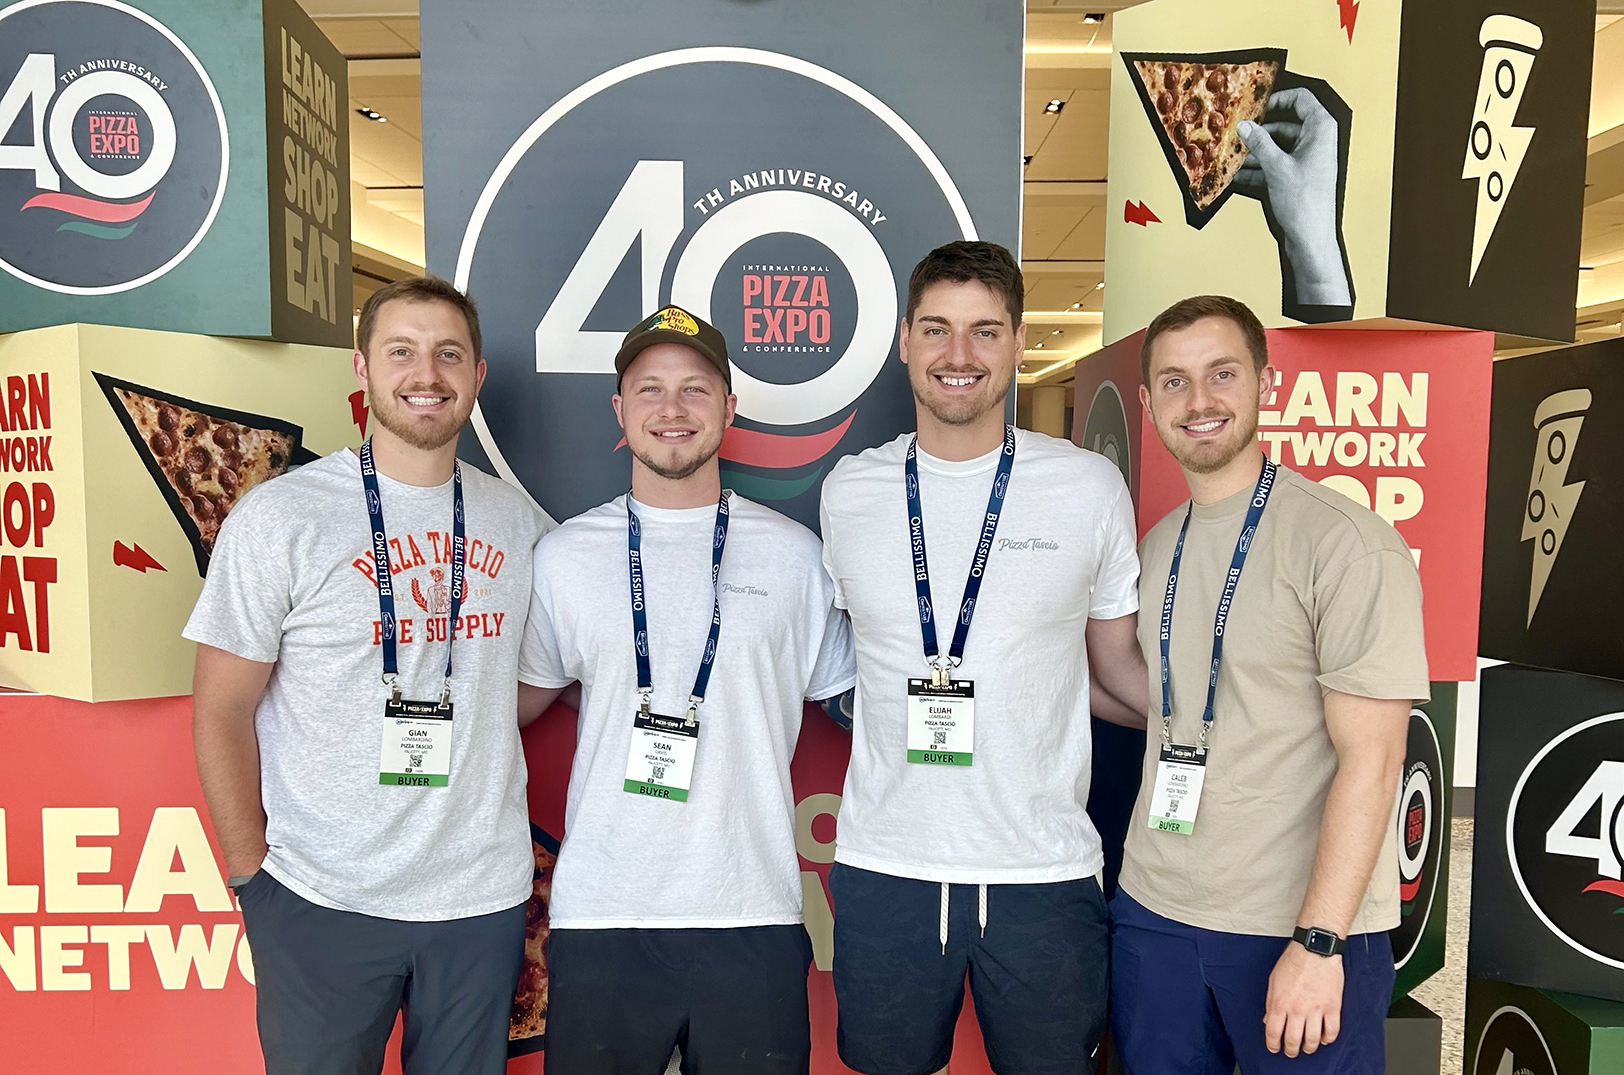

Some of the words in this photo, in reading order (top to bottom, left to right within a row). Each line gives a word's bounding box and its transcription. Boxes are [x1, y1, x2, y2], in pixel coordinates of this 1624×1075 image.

[60, 73, 76, 85] TH
[79, 59, 168, 91] ANNIVERSARY
[280, 26, 336, 131] LEARN
[88, 115, 139, 134] PIZZA
[282, 88, 338, 168] NETWORK
[90, 133, 140, 155] EXPO
[283, 136, 339, 230] SHOP
[693, 188, 725, 215] TH
[729, 169, 887, 226] ANNIVERSARY
[285, 206, 340, 325] EAT
[742, 264, 830, 272] INTERNATIONAL
[535, 160, 898, 426] 40
[743, 274, 830, 307] PIZZA
[667, 308, 690, 320] Bass
[743, 307, 831, 343] EXPO
[755, 345, 831, 353] CONFERENCE
[911, 516, 927, 581] BELLISSIMO
[971, 512, 997, 577] BELLISSIMO
[998, 538, 1029, 551] Pizza
[374, 531, 391, 596] BELLISSIMO
[452, 535, 465, 598] BELLISSIMO
[630, 549, 644, 611] BELLISSIMO
[0, 554, 57, 653] AT
[1161, 574, 1177, 640] BELLISSIMO
[1215, 567, 1240, 636] BELLISSIMO
[426, 612, 505, 642] SUPPLY
[929, 706, 952, 714] ELIJAH
[408, 729, 428, 737] GIAN
[653, 742, 672, 751] SEAN
[923, 753, 954, 763] BUYER
[398, 776, 430, 786] BUYER
[640, 785, 670, 799] BUYER
[1171, 774, 1187, 782] CALEB
[1158, 821, 1180, 832] BUYER
[1545, 760, 1624, 880] 4
[0, 806, 242, 913] LEA
